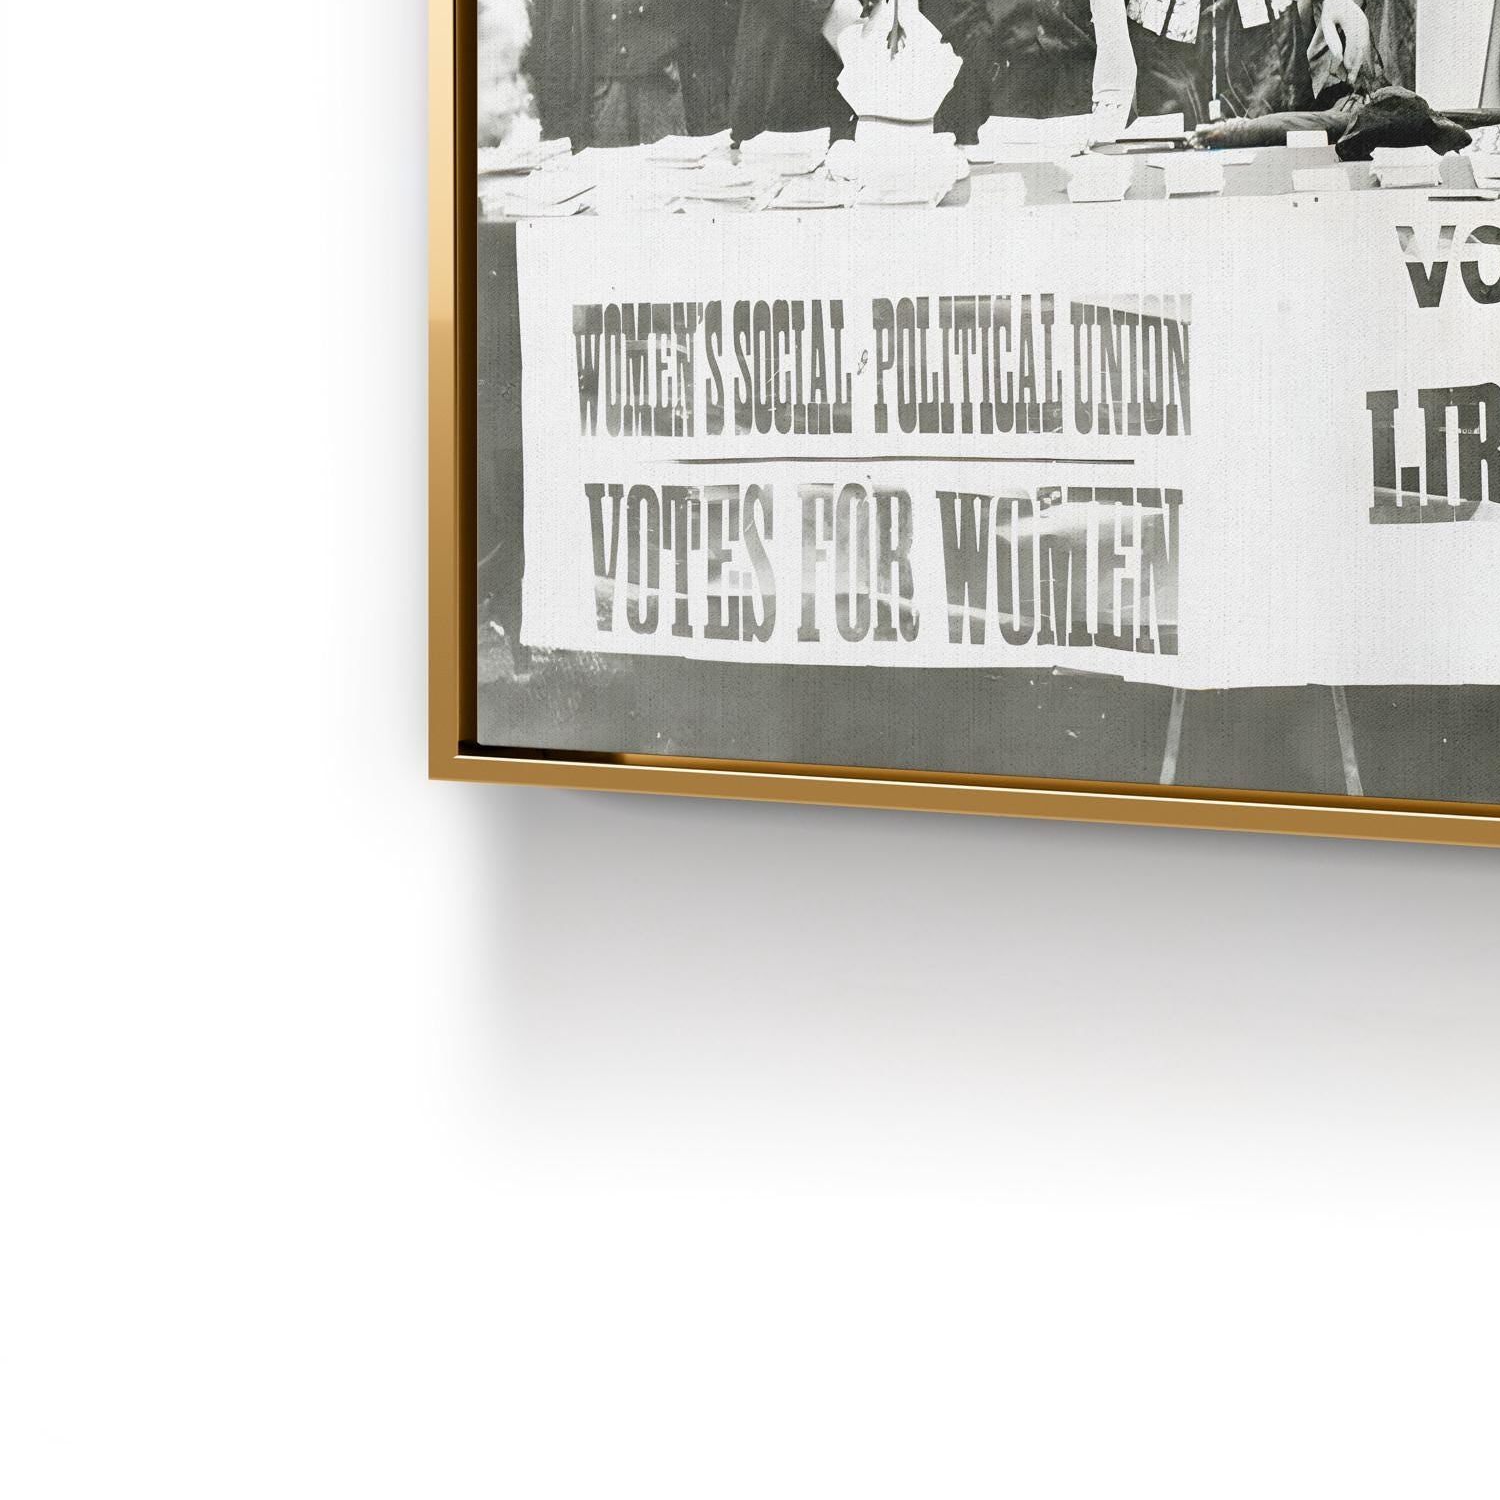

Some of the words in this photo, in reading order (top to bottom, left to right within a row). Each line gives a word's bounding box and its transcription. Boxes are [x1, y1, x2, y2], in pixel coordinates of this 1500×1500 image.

[572, 299, 725, 438] WOMEN'S
[733, 298, 853, 435] SOCIAL
[872, 293, 1064, 434] POLITICAL
[1070, 294, 1193, 436] UNION
[584, 482, 775, 642] VOTES
[797, 482, 920, 642] FOR
[935, 486, 1184, 656] WOMEN
